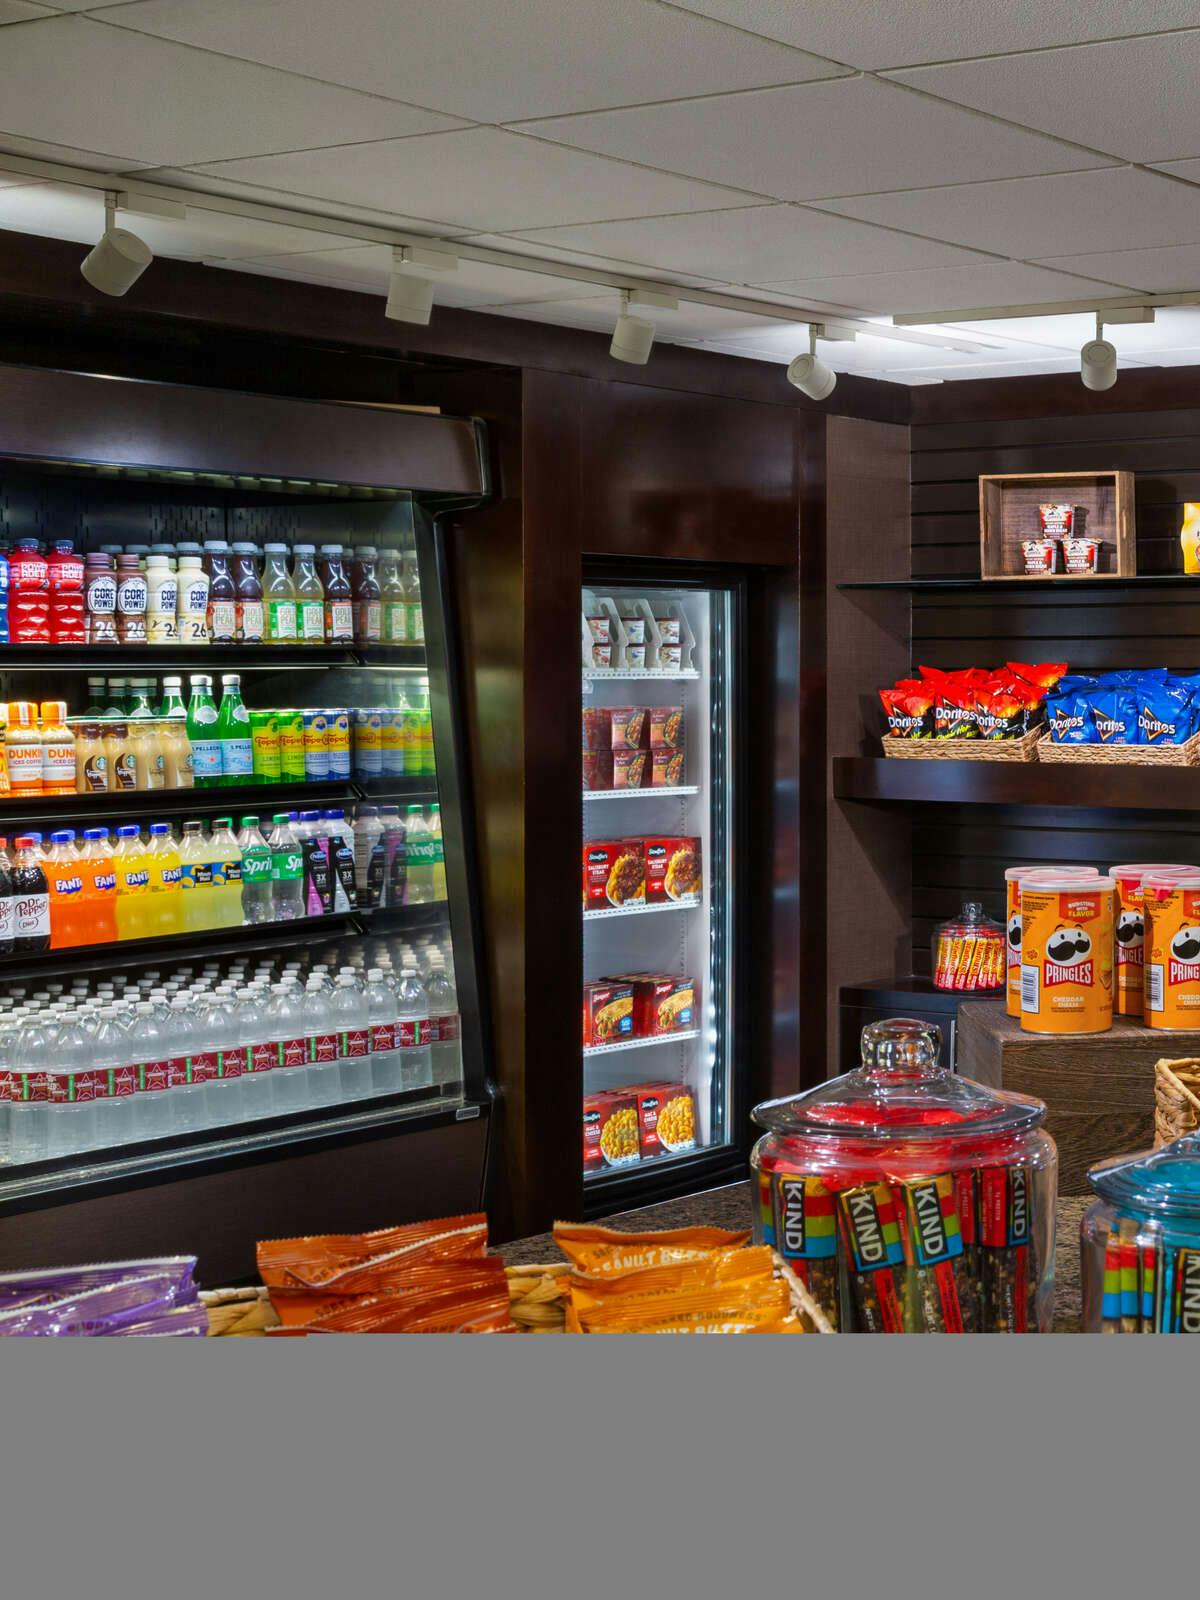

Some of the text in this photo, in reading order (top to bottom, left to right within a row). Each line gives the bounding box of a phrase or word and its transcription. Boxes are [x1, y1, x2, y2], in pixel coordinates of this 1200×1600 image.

[94, 588, 114, 599] CORE
[124, 589, 145, 600] CORE
[191, 622, 207, 638] 26
[936, 707, 976, 720] Doritos
[888, 716, 924, 728] Doritos
[1049, 715, 1084, 730] Doritos
[1096, 719, 1126, 732] oritos
[1138, 715, 1176, 734] Doritos
[48, 749, 75, 759] DUN
[244, 857, 272, 875] Sprit
[94, 874, 115, 887] FANT
[126, 871, 149, 884] FANT
[162, 868, 181, 880] FANT
[56, 877, 82, 891] FANT
[15, 900, 47, 917] Pepper
[27, 899, 40, 908] Dr
[1045, 962, 1092, 984] PRINGLES
[1013, 1170, 1026, 1236] KIND
[784, 1182, 803, 1249] KIND
[914, 1186, 944, 1255] KIND
[850, 1190, 883, 1262] KIND
